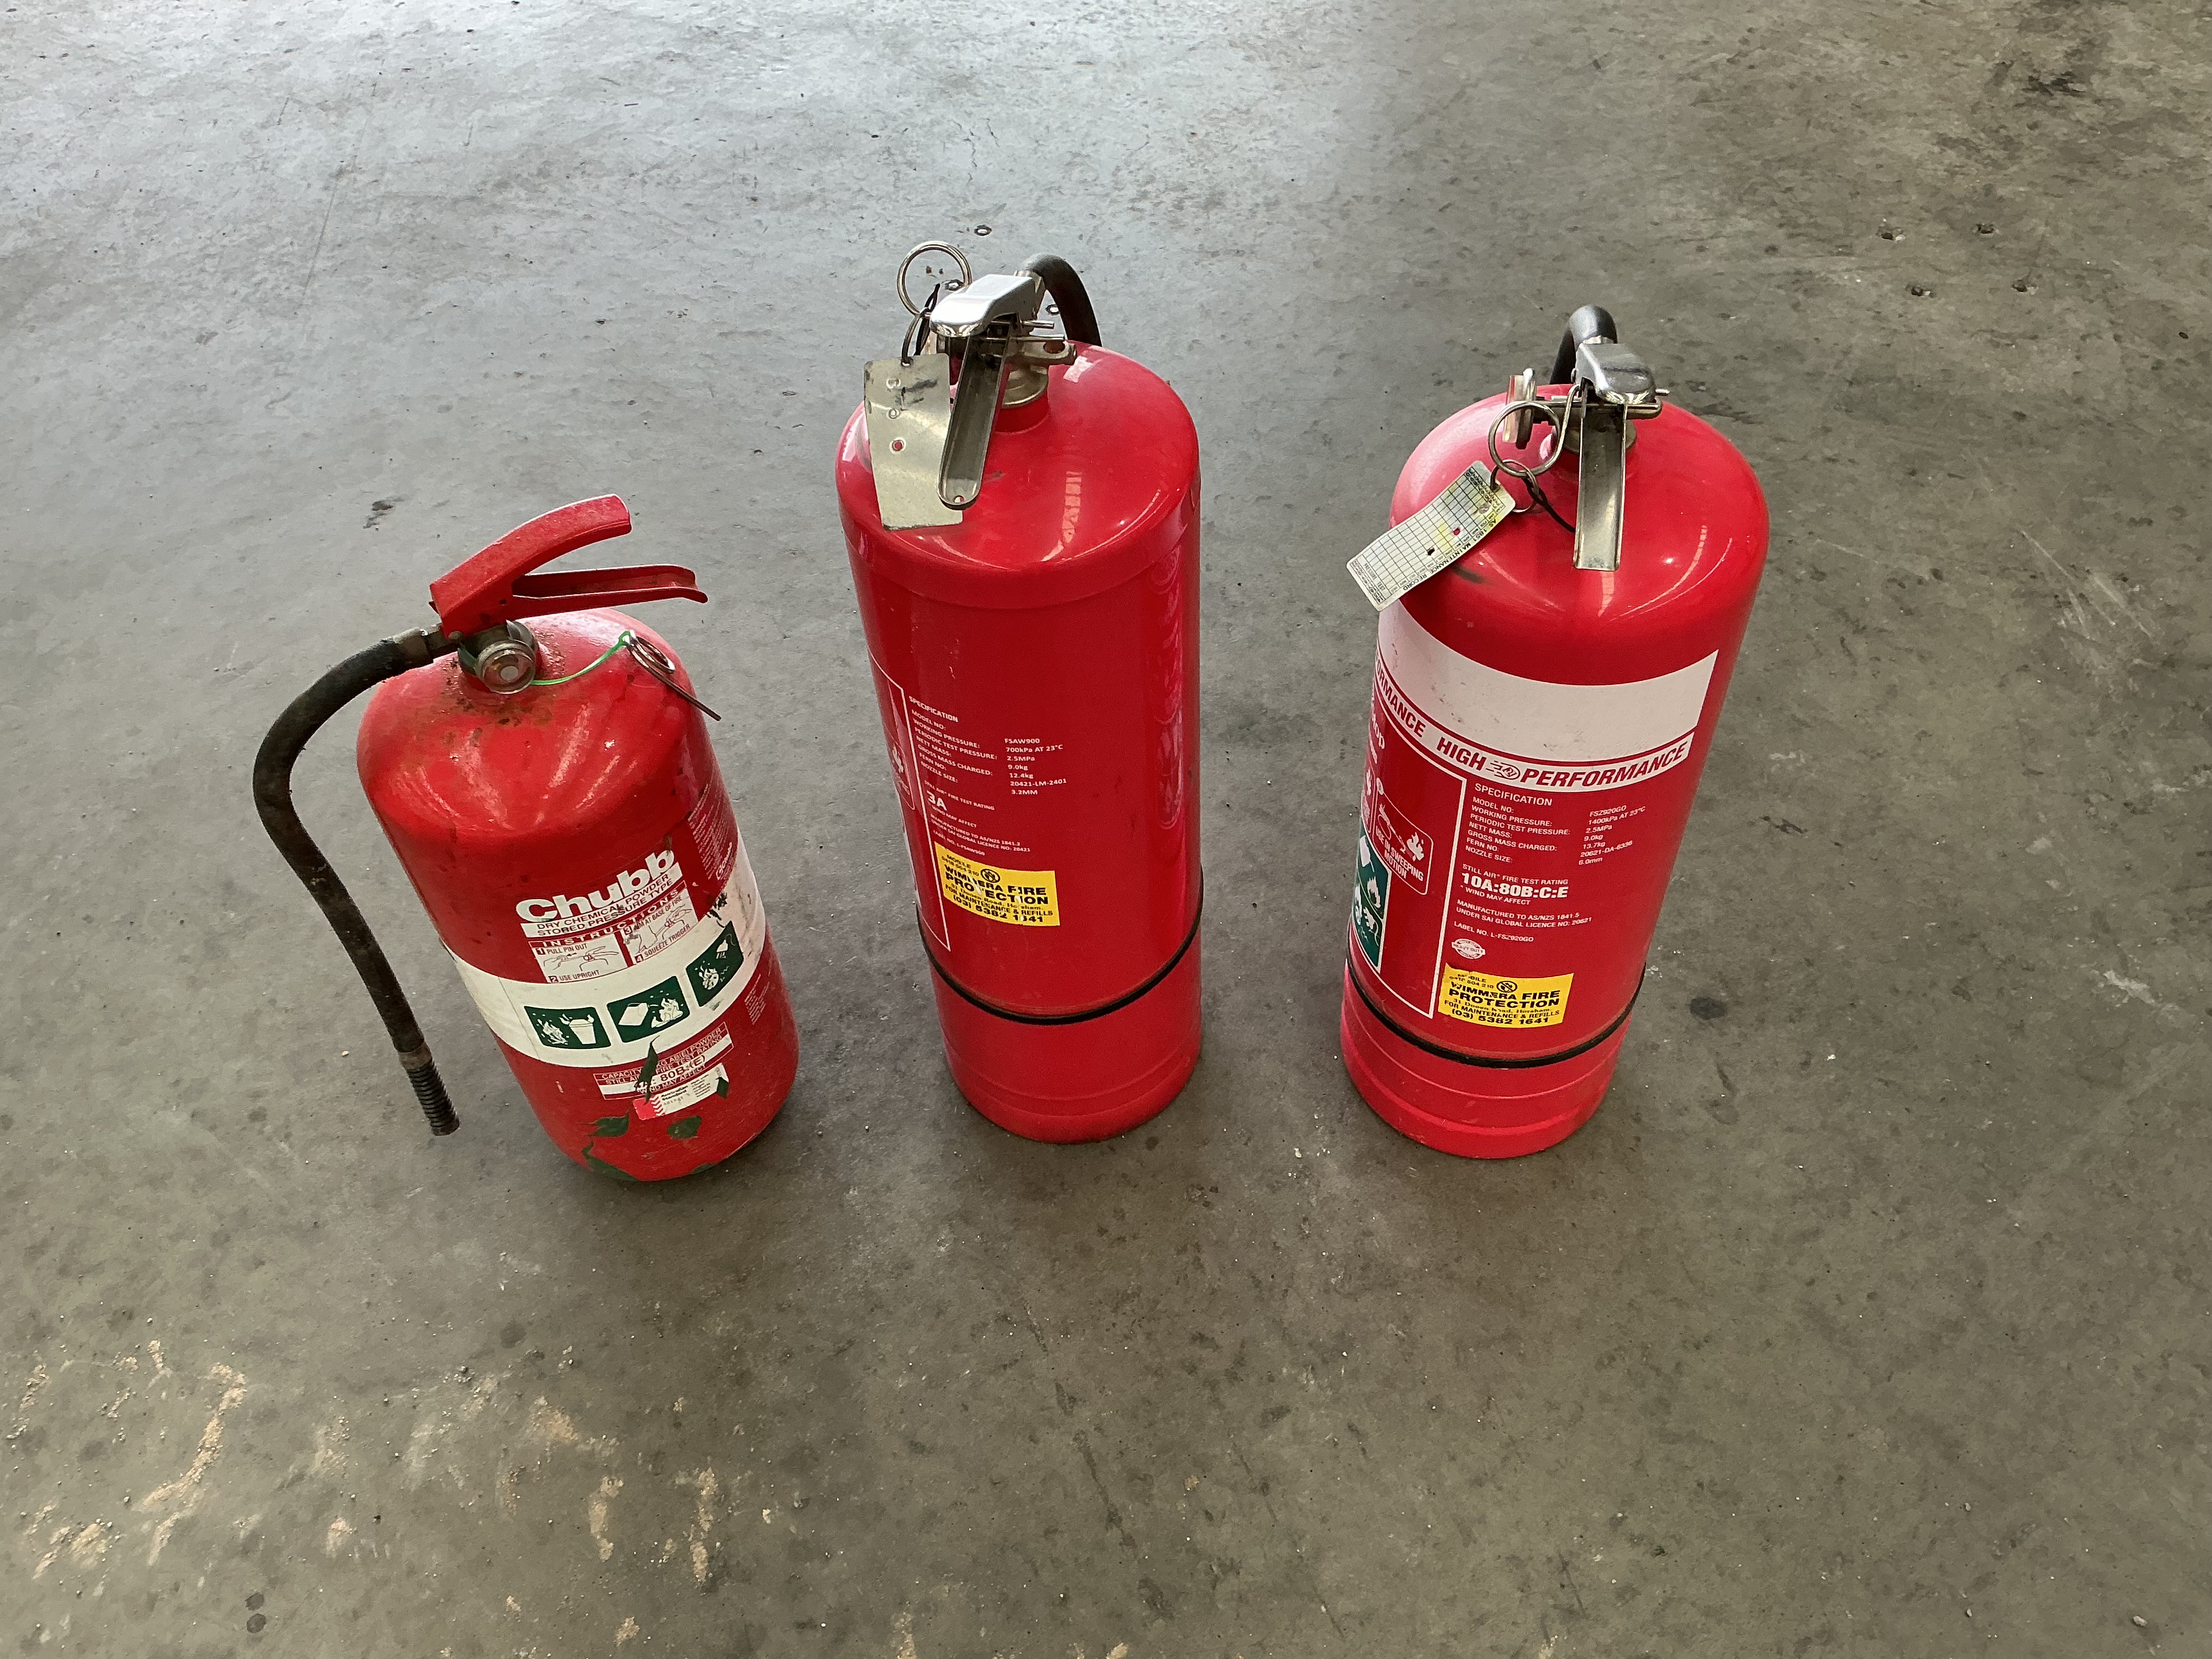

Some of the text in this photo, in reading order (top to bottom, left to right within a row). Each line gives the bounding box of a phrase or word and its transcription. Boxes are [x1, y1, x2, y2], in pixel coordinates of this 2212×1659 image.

[1403, 518, 1497, 591] AS 1851 MAINTENANCE RECORD
[909, 695, 958, 723] SPECIFICATION
[912, 709, 933, 725] MODEL
[913, 718, 980, 748] WORKING PRESSURE:
[915, 727, 997, 759] PERIODIC TEST PRESSURE:
[938, 755, 956, 766] MASS
[957, 763, 993, 776] CHARGED:
[1436, 736, 1487, 771] HIGH
[1520, 741, 1688, 787] PERFORMANCE
[927, 790, 947, 811] 3A
[1473, 797, 1514, 813] MODEL NO:
[1475, 783, 1553, 806] SPECIFICATION
[1470, 813, 1505, 828] PERIODIC
[1506, 823, 1526, 832] TEST
[1471, 805, 1553, 826] WORKING PRESSURE:
[1589, 816, 1617, 825] 1400kPa
[1469, 821, 1513, 838] NETT MASS:
[1585, 825, 1612, 833] 2.5MPa
[1466, 837, 1485, 848] FERN
[1468, 830, 1557, 851] GROSS MASS CHARGED:
[1385, 849, 1407, 879] MOTION
[1391, 847, 1424, 881] SWEEPING
[1466, 845, 1513, 863] NOZZLE SIZE:
[1463, 864, 1481, 875] STILL
[516, 850, 674, 922] Chubb
[945, 872, 1048, 905] PROECTION
[1008, 885, 1046, 895] FIRE
[1462, 872, 1568, 898] 10A:80B:C:E
[1465, 887, 1485, 897] WIND
[1487, 893, 1503, 901] MAY
[538, 878, 673, 935] STORED PRESSURE TYPE
[568, 904, 623, 924] CHEMICAL
[625, 873, 668, 905] POWDER
[652, 911, 664, 921] BASE
[672, 895, 682, 906] FIRE
[1457, 899, 1515, 919] MANUFACTURED
[544, 889, 679, 948] INSTRUCTIONS
[1456, 906, 1480, 919] UNDER
[1495, 918, 1523, 927] GLOBAL
[1454, 921, 1488, 936] LABEL NO.
[644, 940, 668, 957] SQUEEZE
[669, 924, 691, 943] TRIGGER
[573, 970, 600, 980] UPRIGHT
[1449, 989, 1559, 1008] PROTECTION
[1451, 981, 1561, 1000] WIMMERA FIRE
[1444, 1000, 1459, 1008] FOR
[1461, 1006, 1518, 1019] MAINTENANCE
[1529, 1010, 1560, 1018] REFILLS
[1452, 1008, 1474, 1020] (03)
[1478, 1015, 1513, 1025] 5382
[602, 1068, 642, 1080] CAPACITY
[691, 1028, 721, 1051] POWDER
[656, 1064, 674, 1074] FIRE
[677, 1054, 696, 1065] TEST
[697, 1035, 722, 1055] RATING
[662, 1080, 677, 1090] MAY
[679, 1064, 707, 1082] AFFECT
